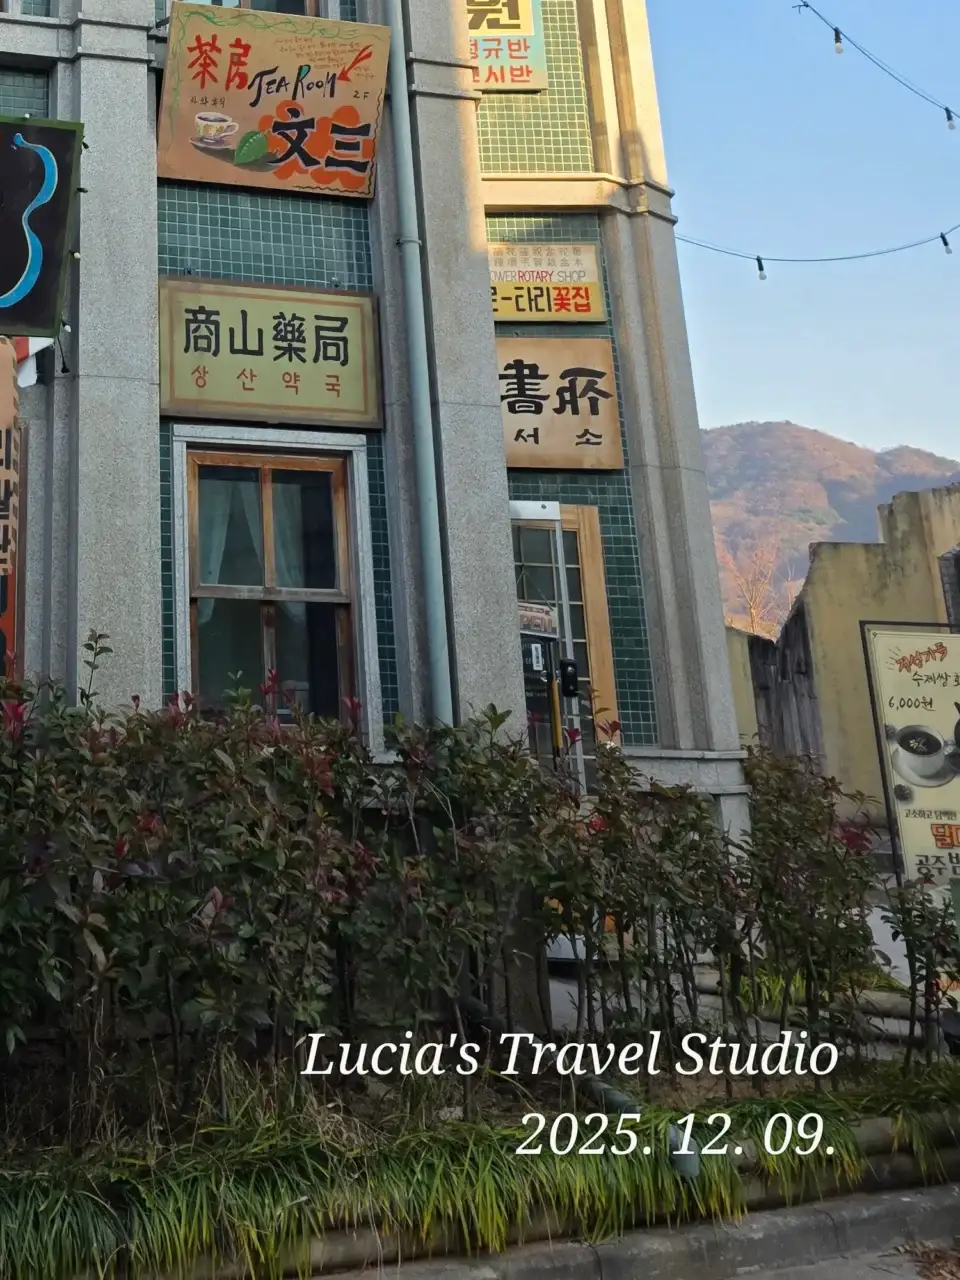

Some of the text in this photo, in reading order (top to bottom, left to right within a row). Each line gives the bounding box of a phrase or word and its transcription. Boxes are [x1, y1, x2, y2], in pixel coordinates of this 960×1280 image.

[187, 34, 252, 91] 茶房
[248, 66, 290, 107] TEA
[517, 270, 555, 282] ROTARY
[557, 270, 586, 282] SHOP
[183, 305, 349, 367] 商山藥局
[888, 695, 937, 712] 6,000원
